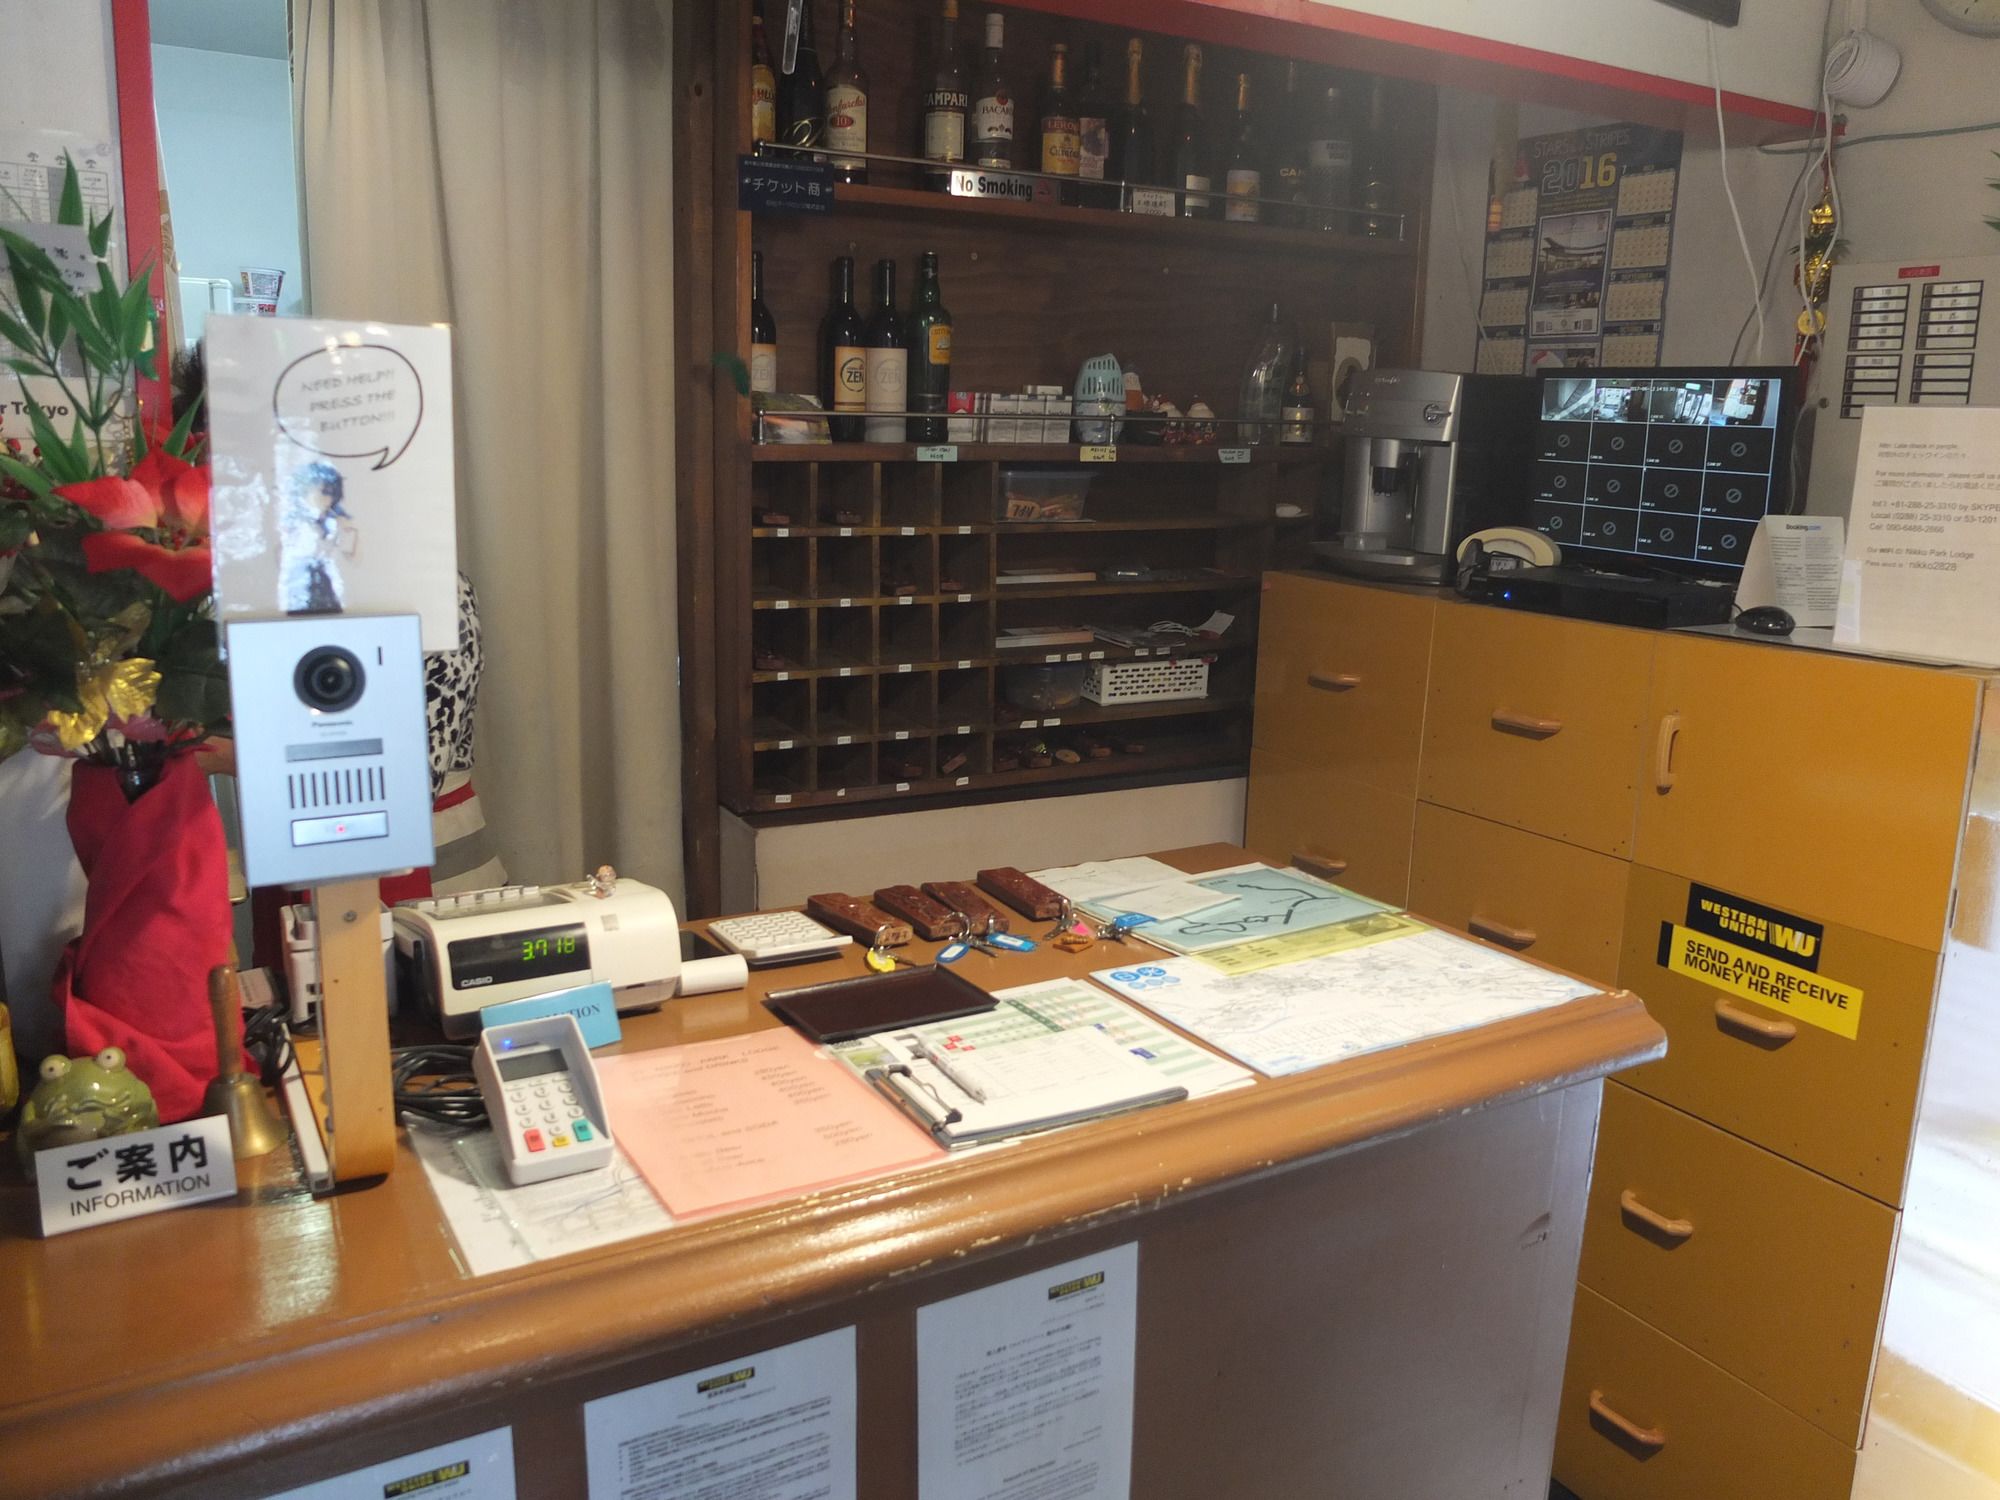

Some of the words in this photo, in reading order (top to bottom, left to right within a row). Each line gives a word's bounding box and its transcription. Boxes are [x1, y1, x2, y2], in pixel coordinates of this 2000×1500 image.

[954, 175, 973, 192] No
[977, 176, 1033, 200] Smoking
[1541, 152, 1618, 196] 2016
[11, 401, 69, 419] Toyo
[309, 395, 363, 412] PRESS
[1701, 898, 1769, 930] WESTERN
[1719, 916, 1767, 942] UNION
[1774, 924, 1818, 957] WU
[461, 976, 493, 988] CASIO
[1684, 953, 1743, 985] MONEY
[1748, 977, 1791, 1004] HERE
[1686, 939, 1729, 965] SEND
[1733, 957, 1770, 980] AND
[1775, 970, 1849, 1010] RECEIVE
[66, 1133, 208, 1191] ご案内
[70, 1173, 211, 1216] INFORMATION
